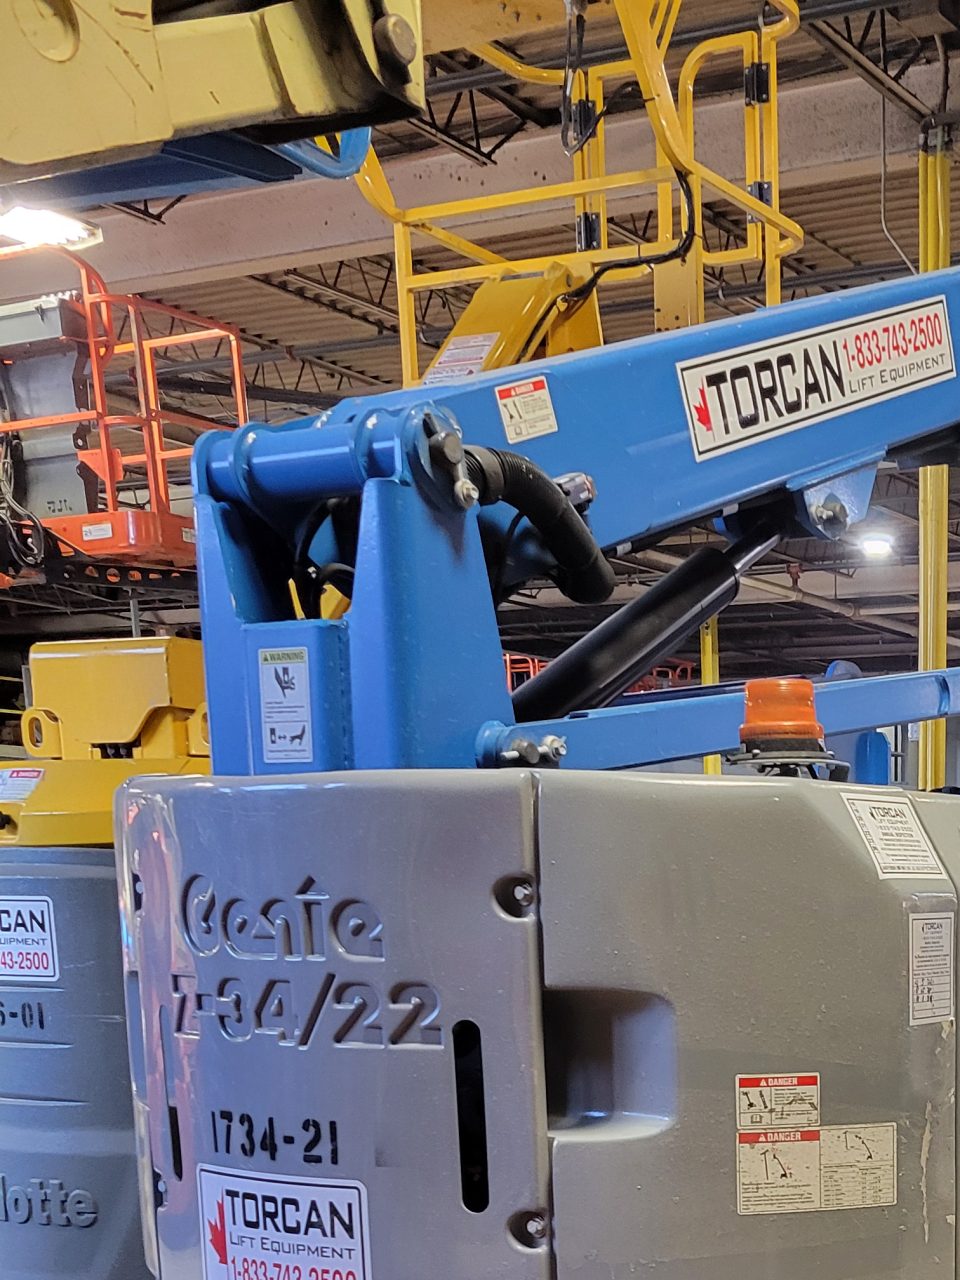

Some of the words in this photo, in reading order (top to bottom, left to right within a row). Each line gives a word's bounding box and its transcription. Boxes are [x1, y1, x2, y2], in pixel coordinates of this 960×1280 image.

[842, 313, 943, 372] 1-833-743-2500
[706, 340, 846, 435] TORCAN
[849, 375, 875, 394] LIFT
[880, 353, 946, 384] EQUIPMENT
[269, 651, 304, 661] WARNING
[872, 806, 907, 819] TORCAN
[181, 874, 386, 962] Genie
[171, 972, 444, 1050] Z-34/22
[768, 1077, 798, 1086] DANGER
[211, 1110, 339, 1165] 1734-21
[767, 1132, 801, 1142] DANGER
[225, 1189, 355, 1239] TORCAN
[229, 1231, 256, 1248] LIFT
[260, 1236, 356, 1260] EQUIPMENT
